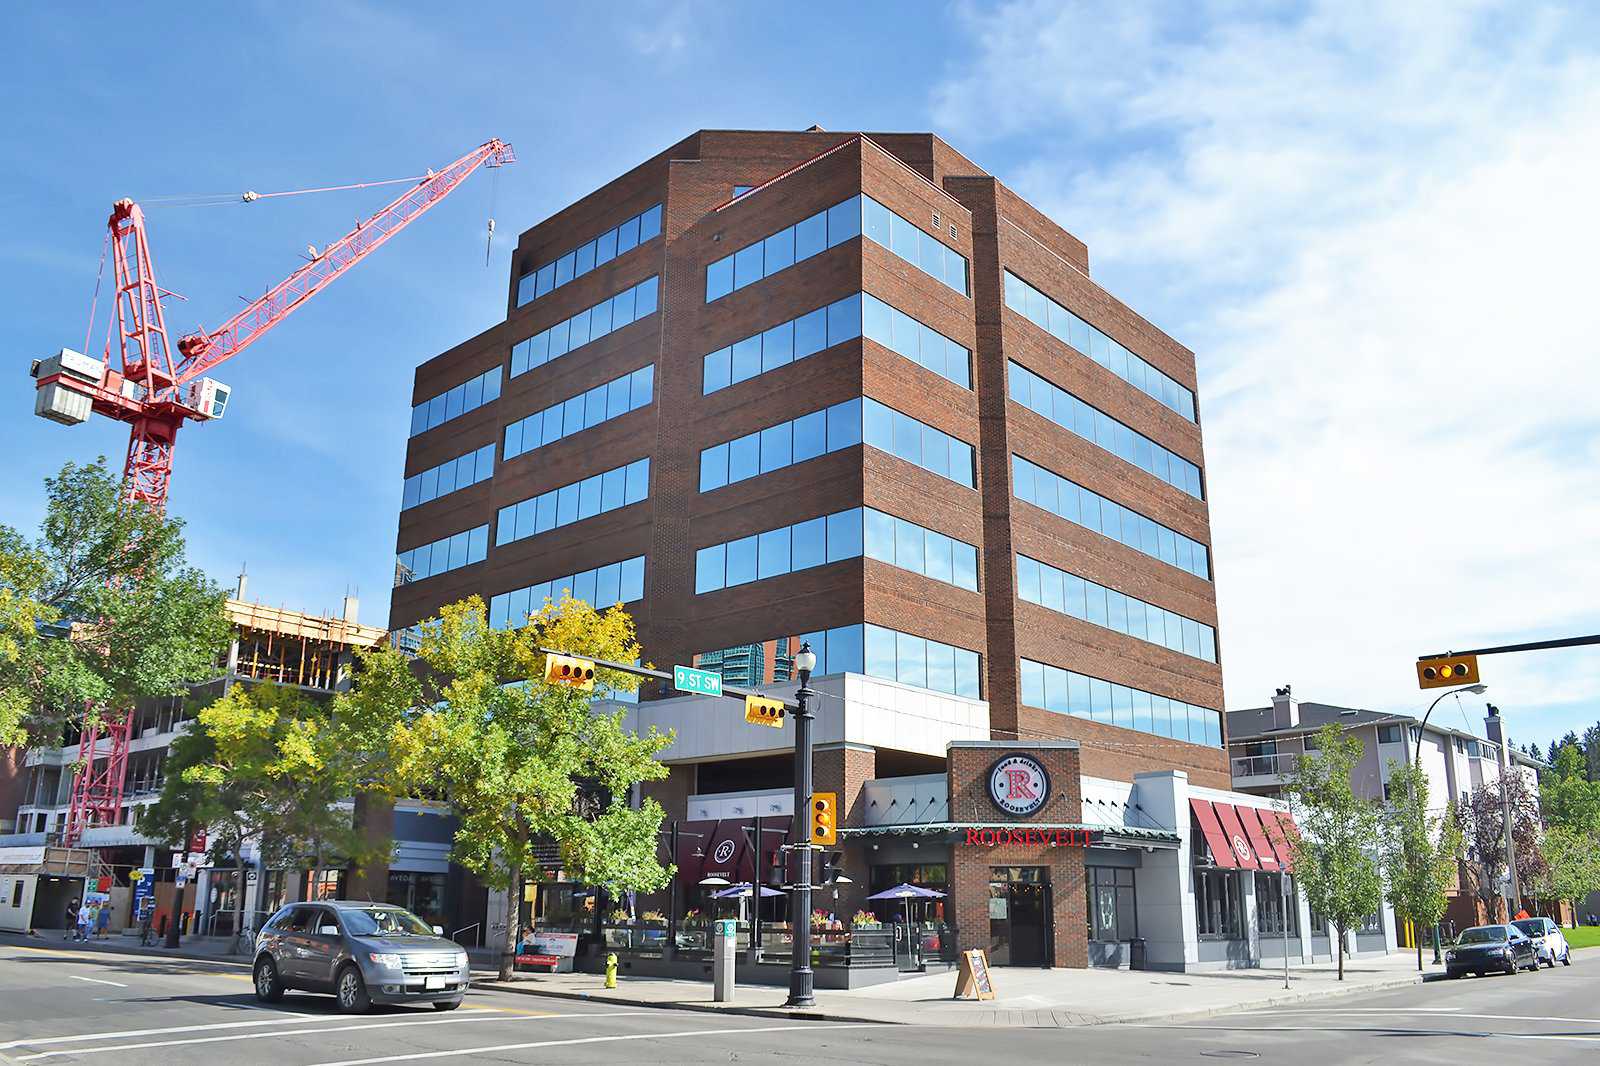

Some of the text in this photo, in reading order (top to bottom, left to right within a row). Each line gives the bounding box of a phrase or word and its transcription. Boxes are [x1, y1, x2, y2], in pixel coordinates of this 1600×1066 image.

[677, 671, 720, 691] 9 ST SW
[1005, 769, 1036, 800] R
[999, 797, 1041, 813] ROOSEVELT
[965, 829, 1091, 848] ROOSEVELT
[719, 845, 729, 856] R
